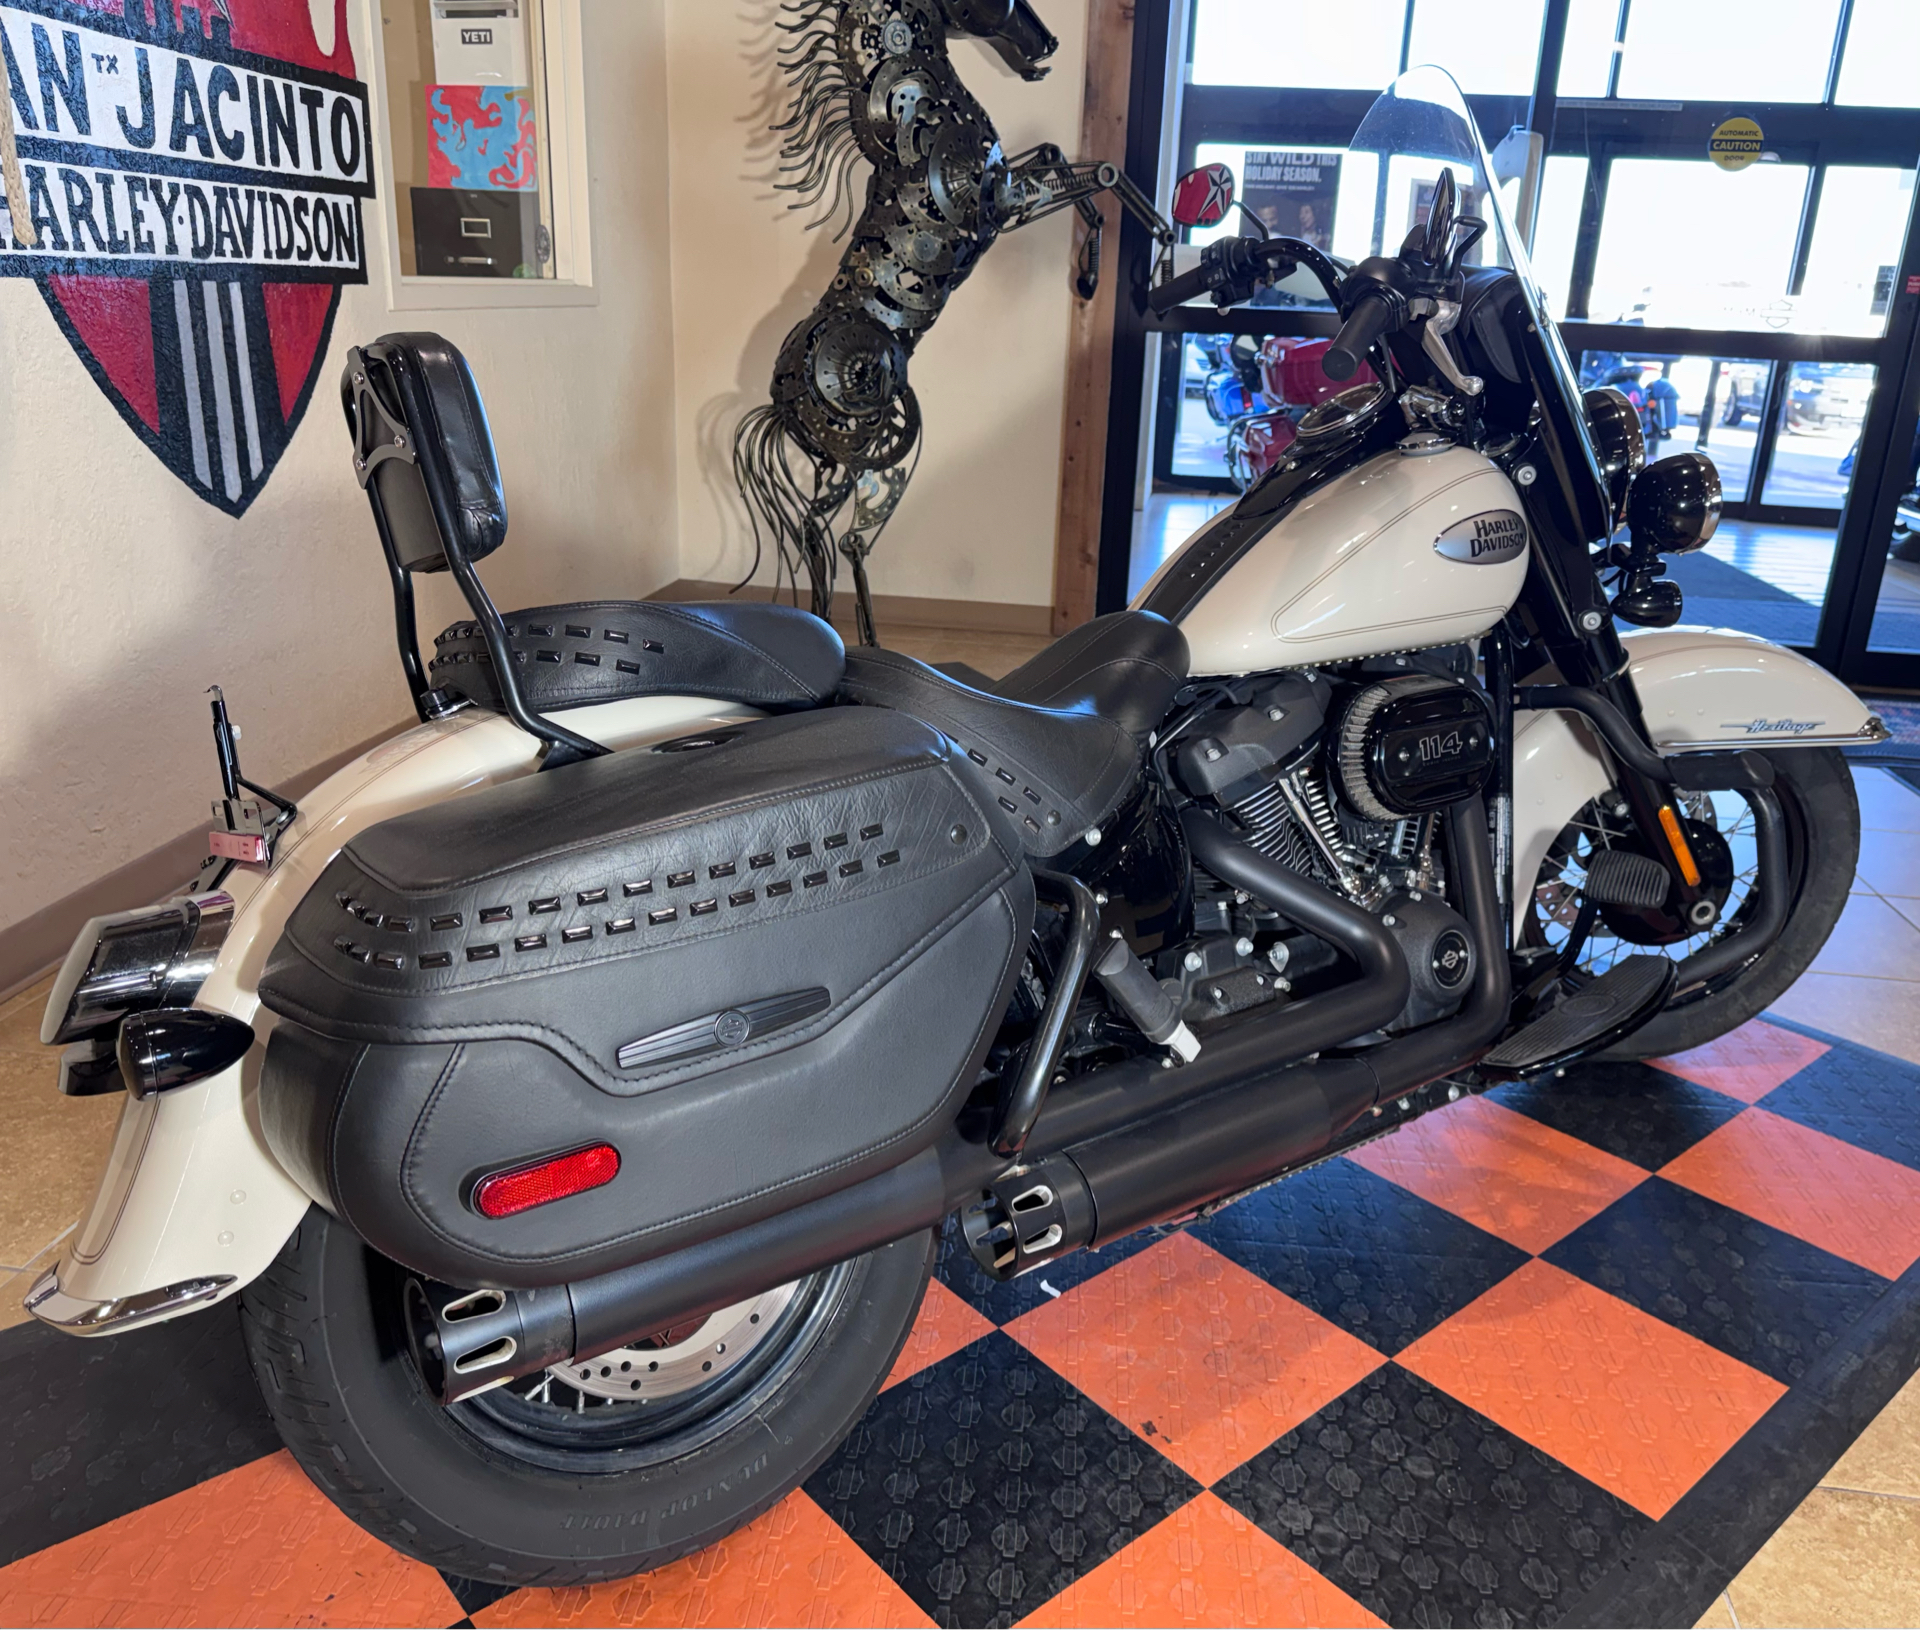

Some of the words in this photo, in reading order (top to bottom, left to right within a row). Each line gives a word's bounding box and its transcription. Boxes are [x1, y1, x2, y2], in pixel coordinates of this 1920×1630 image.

[462, 31, 491, 43] YETI
[91, 52, 120, 75] TX
[115, 47, 360, 177] JACINTO
[1713, 141, 1761, 150] CAUTION
[1269, 152, 1315, 165] WILD
[1245, 165, 1283, 181] HOLIDAY
[1283, 167, 1322, 183] SEASON.
[1473, 518, 1520, 538] HARLEY
[1749, 719, 1816, 734] Heritage
[1419, 731, 1463, 761] 114
[660, 1453, 768, 1519] DUNLOP
